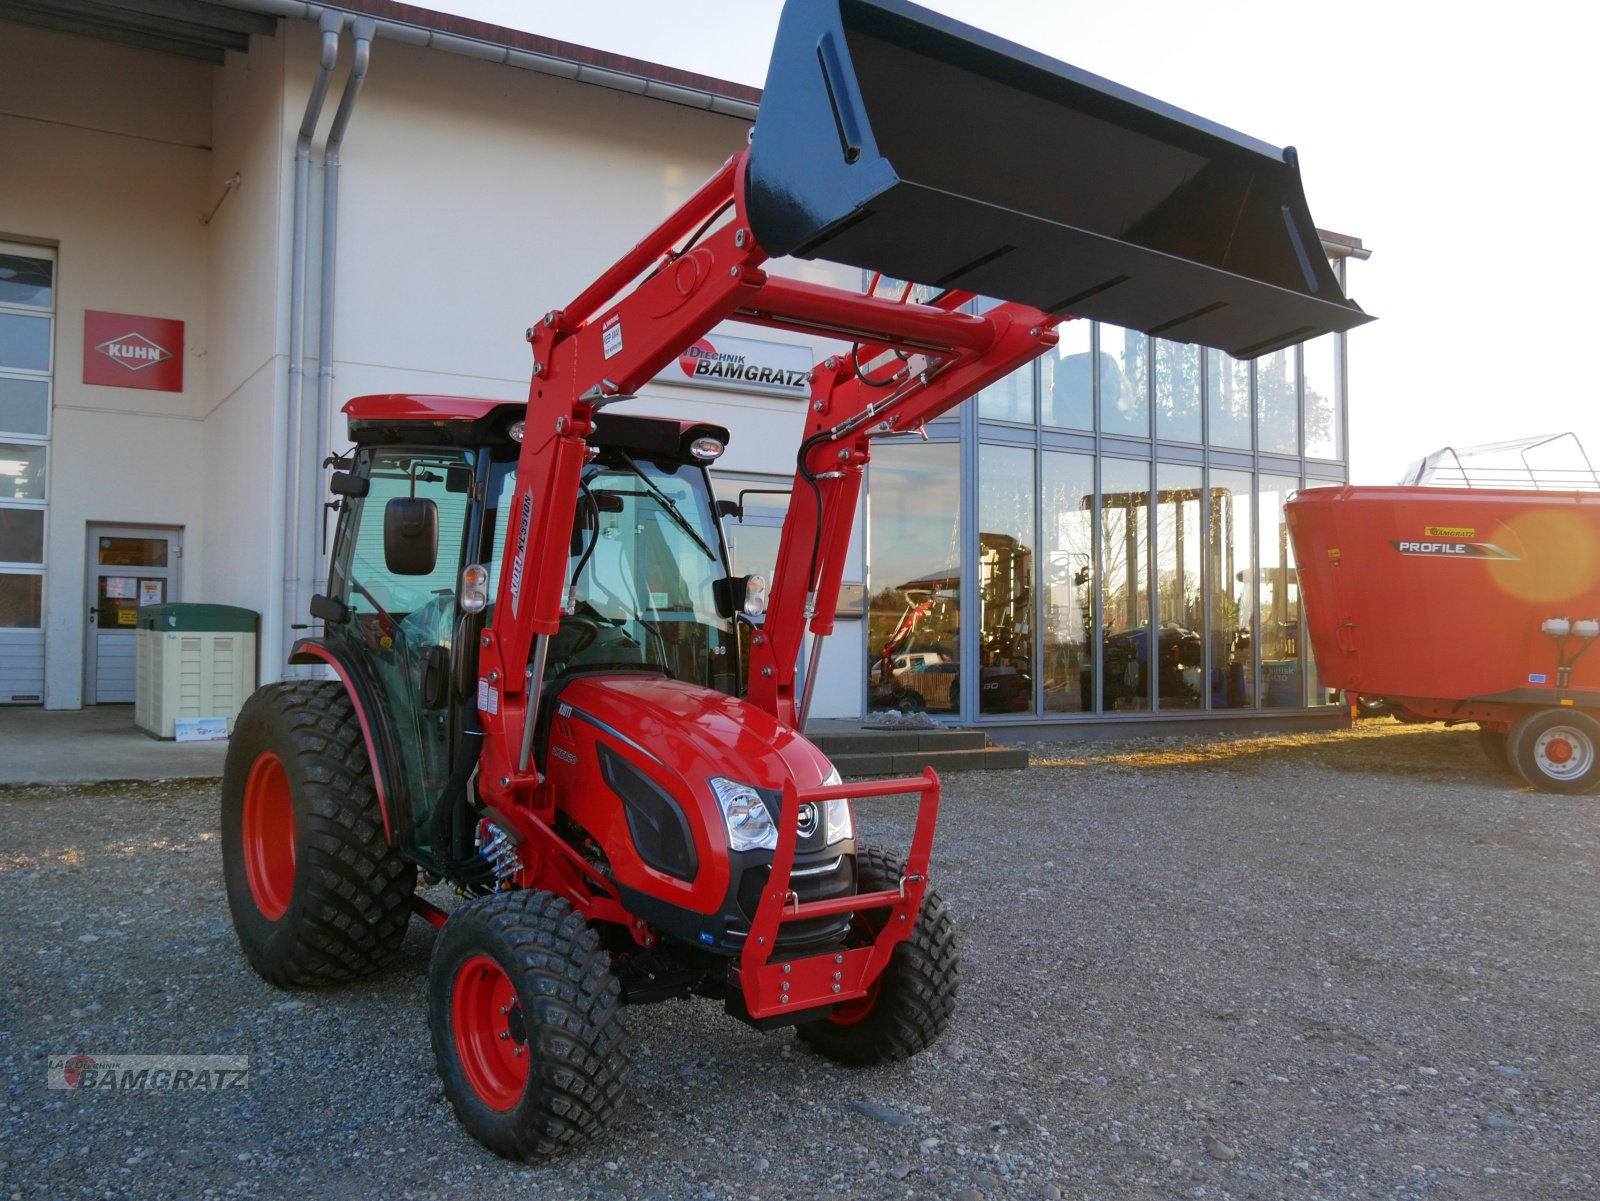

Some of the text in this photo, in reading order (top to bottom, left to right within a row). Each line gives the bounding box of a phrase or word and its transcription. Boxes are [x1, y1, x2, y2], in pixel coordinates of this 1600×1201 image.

[108, 344, 160, 360] KUHN
[695, 359, 806, 387] BAMGRATZ
[1399, 542, 1465, 553] PROFILE
